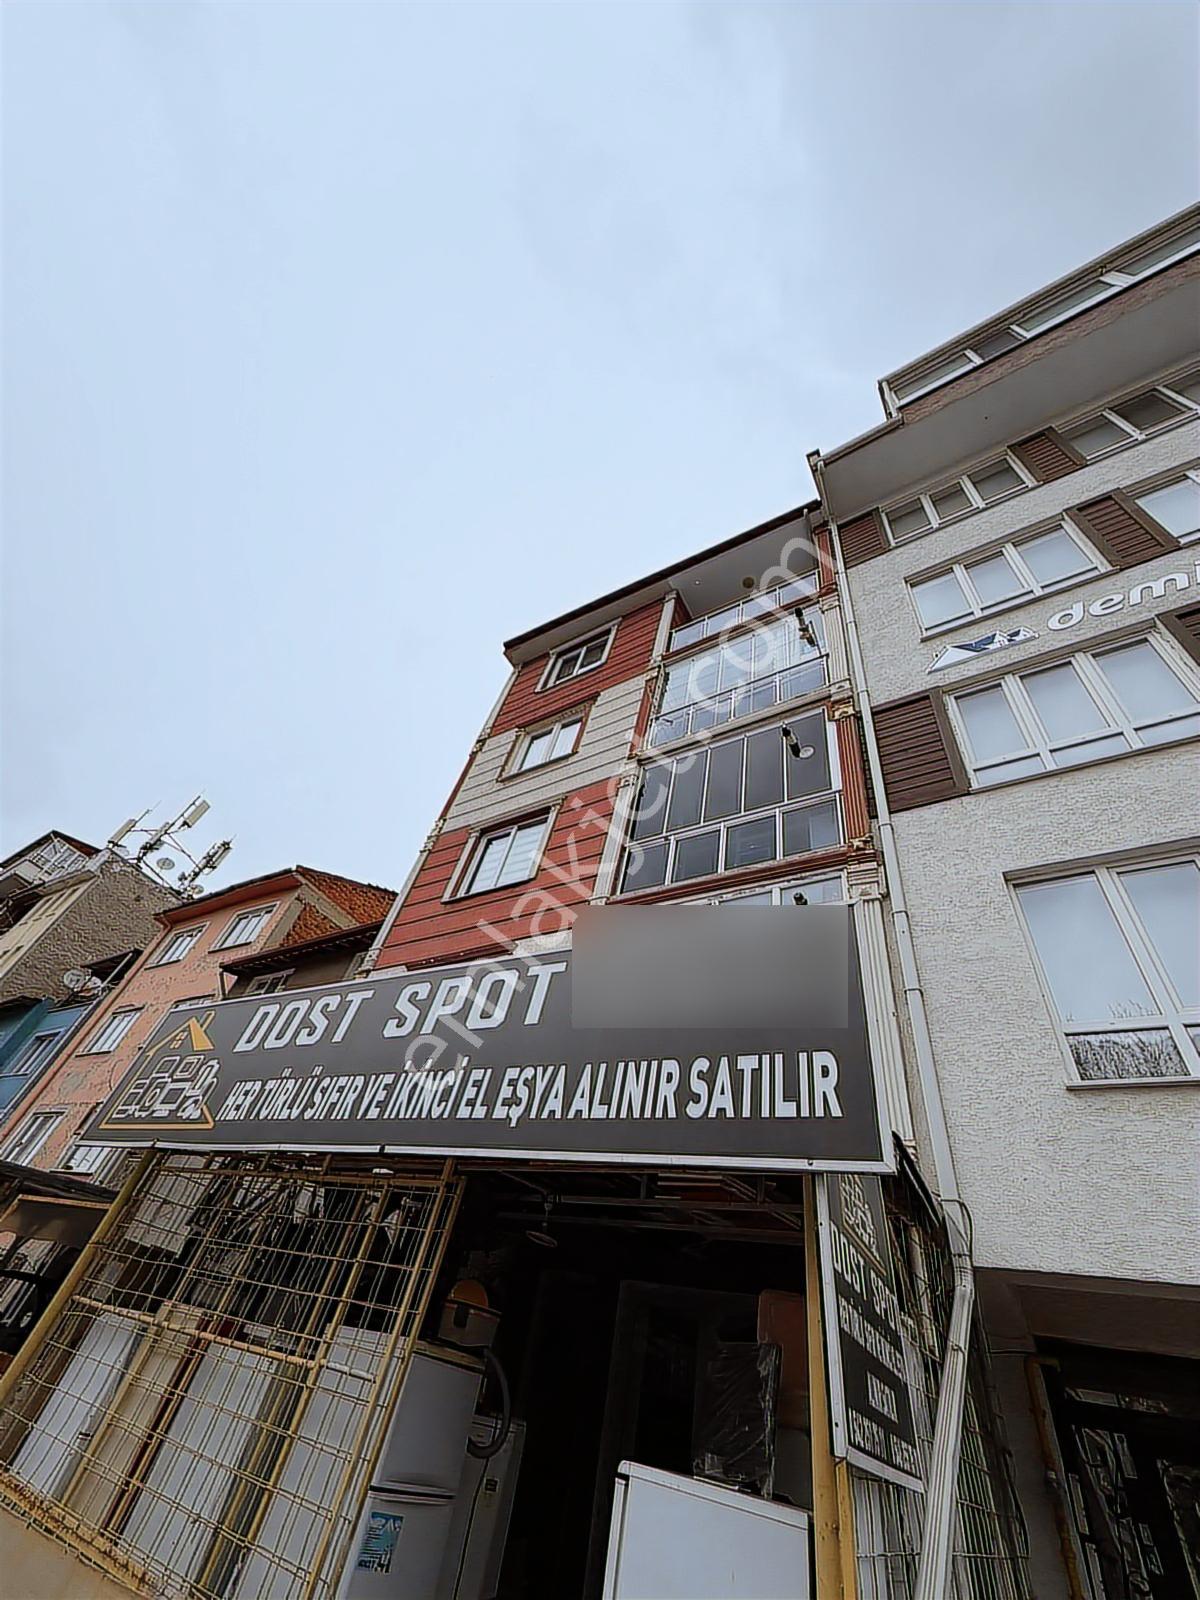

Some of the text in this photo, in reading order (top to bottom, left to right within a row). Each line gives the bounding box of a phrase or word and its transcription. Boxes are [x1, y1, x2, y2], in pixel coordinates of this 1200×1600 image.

[232, 961, 568, 1053] DOST SPOT
[217, 1050, 845, 1128] HER TÜRLÜ SIFIR VE İKİNCİ EL EŞYA ALINIR SATILIR
[830, 1220, 868, 1301] DOST
